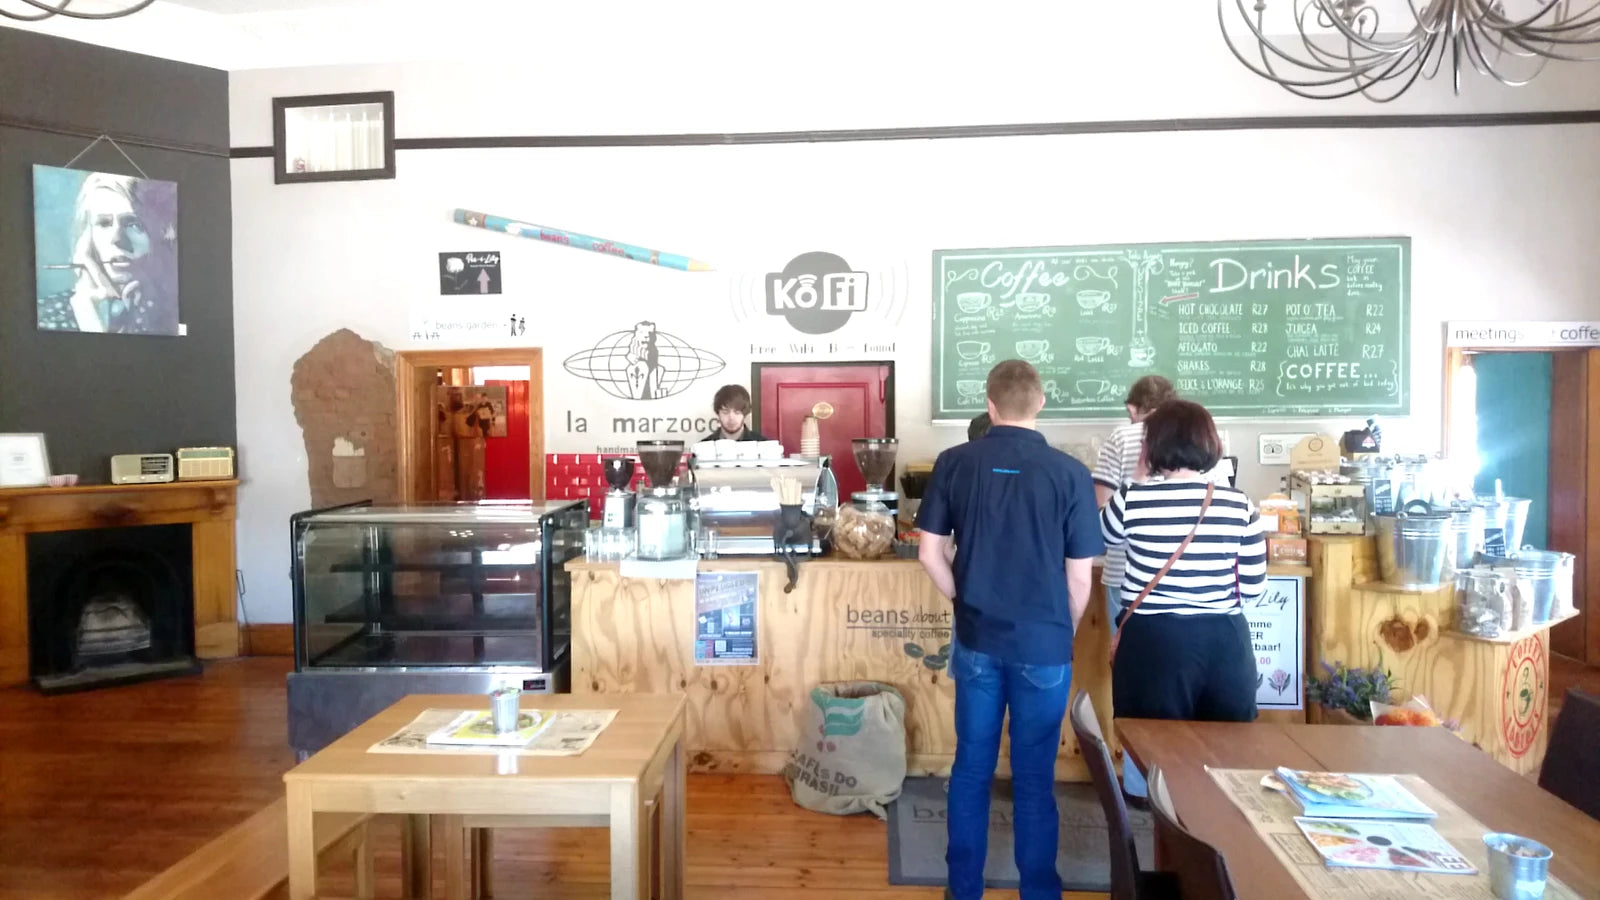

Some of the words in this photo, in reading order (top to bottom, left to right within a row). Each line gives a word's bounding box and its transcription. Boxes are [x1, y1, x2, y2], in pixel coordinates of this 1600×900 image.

[980, 260, 1070, 299] Coffee
[1209, 254, 1340, 293] Drinks
[1178, 303, 1195, 315] HOT
[1199, 303, 1243, 316] CHOCOLATE
[1252, 303, 1268, 316] R27
[1285, 303, 1301, 316] POT
[1315, 303, 1336, 316] TEA
[1366, 303, 1384, 317] R22
[435, 320, 463, 330] beans
[466, 320, 498, 332] garden
[1179, 322, 1199, 334] ICED
[1201, 322, 1231, 334] COFFEE
[1365, 322, 1382, 335] R24
[1455, 327, 1524, 343] meetings
[750, 343, 777, 354] Free
[1177, 342, 1218, 353] AFFOGATO
[1251, 341, 1268, 353] R22
[1286, 345, 1309, 358] CHAI
[1362, 344, 1385, 359] R27
[1177, 360, 1210, 372] SHAKES
[1250, 360, 1266, 372] R28
[1363, 379, 1373, 387] bed
[567, 410, 588, 432] la
[612, 417, 721, 433] marzocc
[847, 604, 909, 625] beans
[912, 605, 952, 624] about
[919, 629, 950, 639] coffee
[1250, 631, 1263, 641] ER
[834, 771, 857, 788] DO
